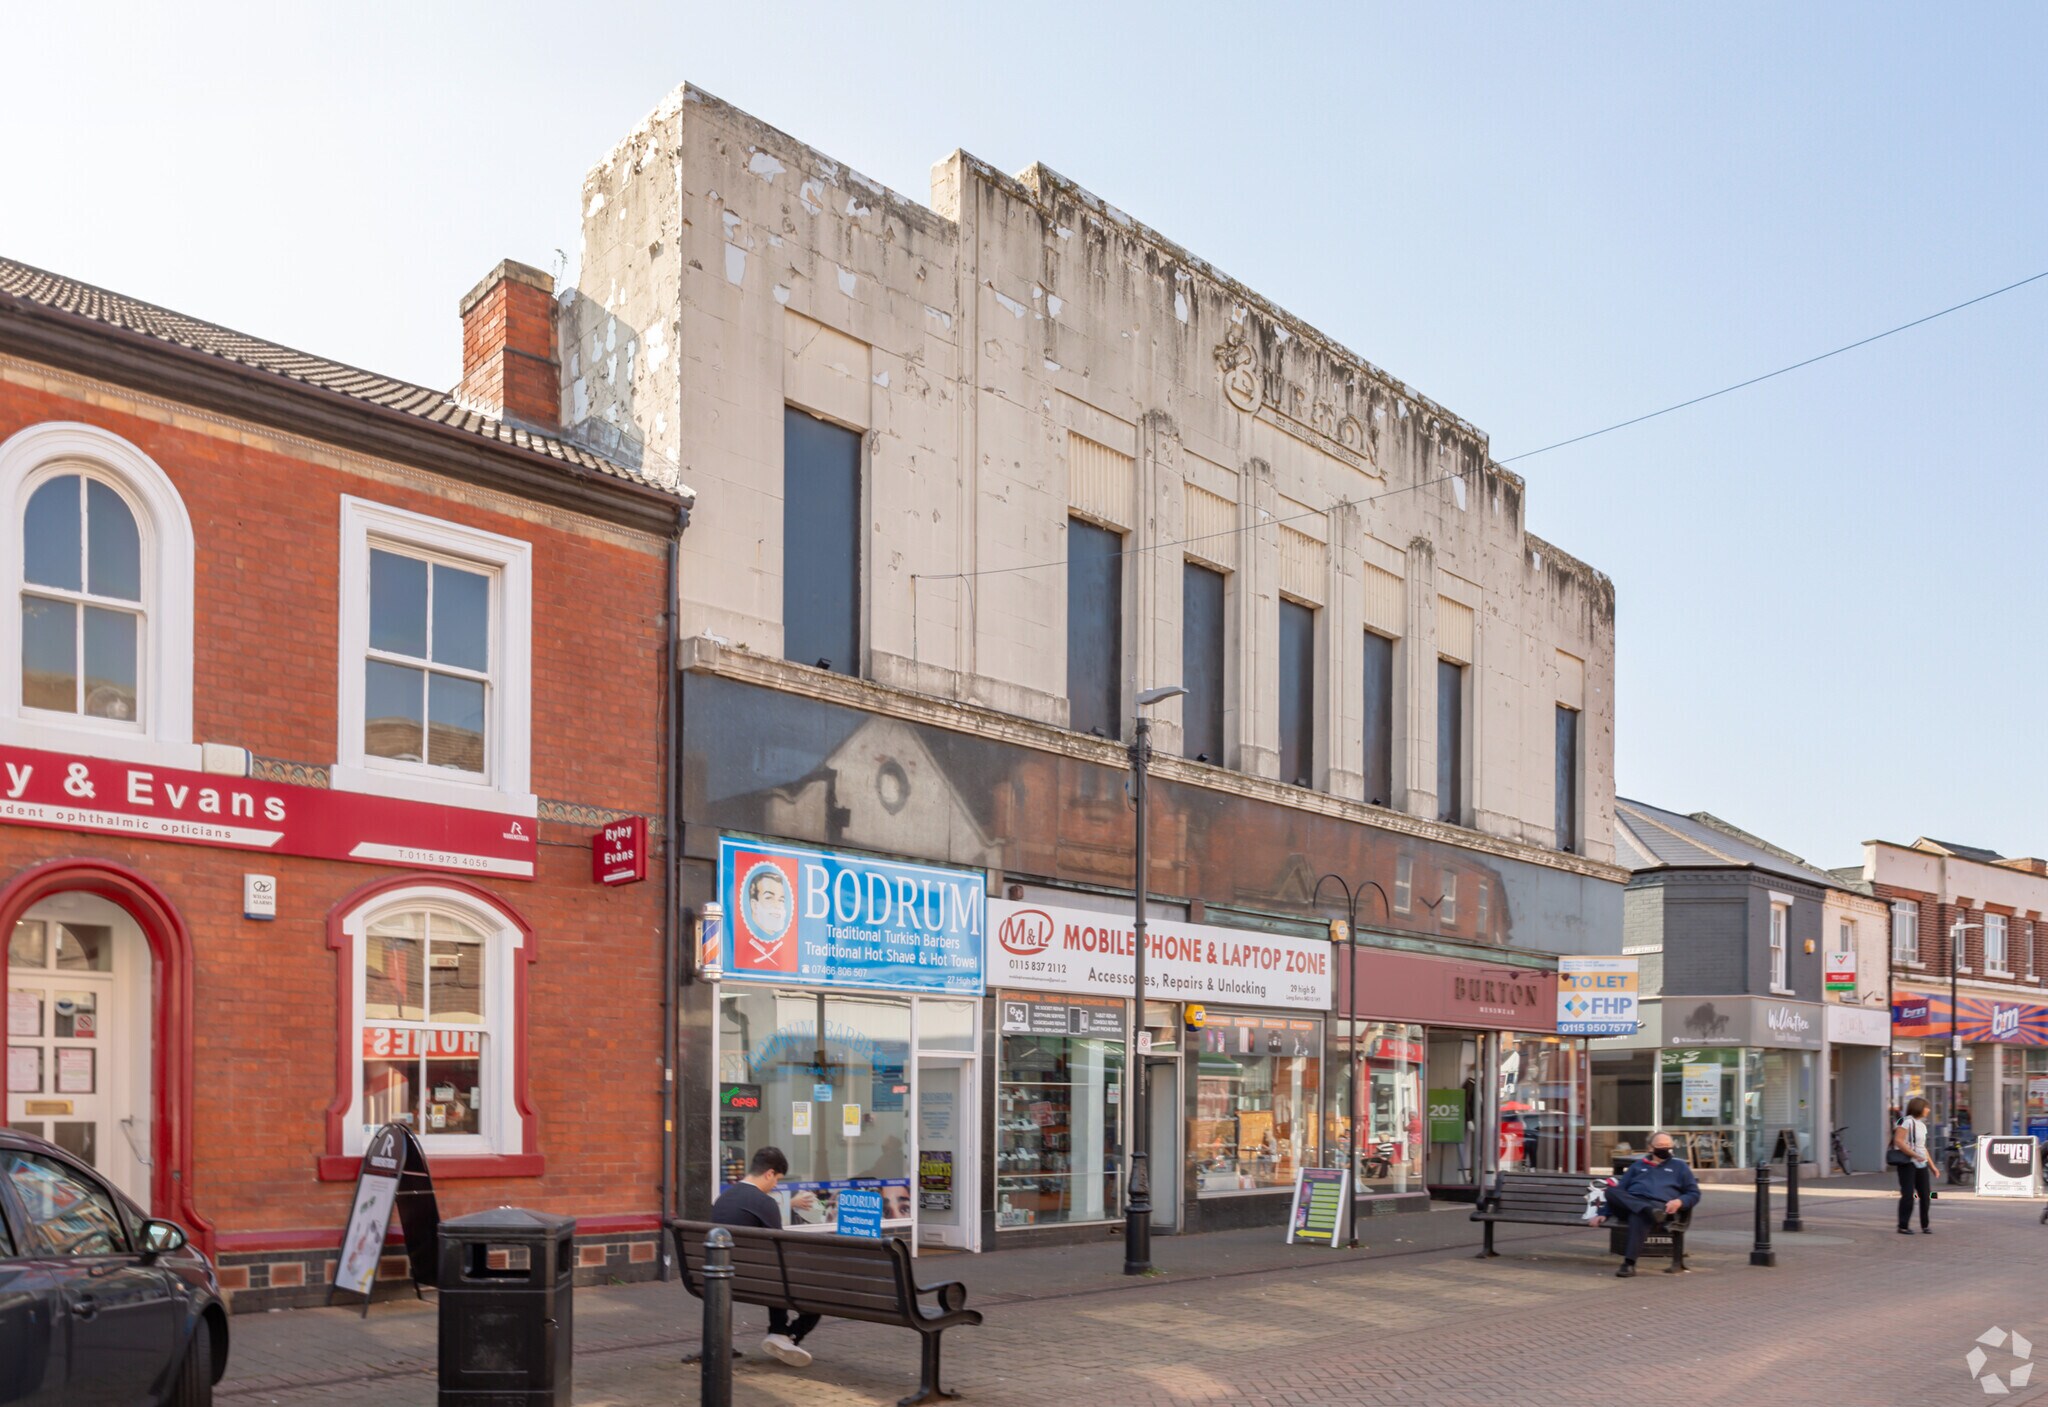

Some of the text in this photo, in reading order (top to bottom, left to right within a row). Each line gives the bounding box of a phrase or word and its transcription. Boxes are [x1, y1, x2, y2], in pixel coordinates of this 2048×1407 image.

[63, 762, 98, 800] &
[127, 769, 287, 822] Evans
[56, 811, 150, 830] ophthalmic
[161, 822, 232, 840] opticians
[605, 825, 633, 843] Ryley
[438, 853, 458, 865] 973
[462, 856, 489, 869] 4056
[603, 848, 634, 866] Evans
[804, 864, 980, 935] BODRUM
[826, 924, 961, 949] Traditional Turkish Barbers
[1004, 917, 1049, 947] M&L
[805, 941, 978, 969] Traditional Hot Shave & Hot Towel
[1063, 923, 1135, 956] MOBILE
[1206, 941, 1218, 965] &
[1222, 942, 1282, 971] LAPTOP
[1285, 950, 1326, 975] ZONE
[811, 965, 836, 977] 07466
[1009, 959, 1067, 973] 0115 837 2112
[1088, 966, 1159, 989] Accessoes,
[1162, 973, 1204, 991] Repairs
[1206, 977, 1215, 991] &
[1218, 978, 1267, 998] Unlocking
[1290, 984, 1317, 996] 29 high St
[1569, 975, 1628, 988] TO LET
[1454, 976, 1538, 1007] BURTON
[1478, 1006, 1516, 1016] MENSWEAR
[1591, 997, 1633, 1015] FHP
[1561, 1023, 1633, 1033] 0115 950 7577
[731, 1097, 758, 1108] OPEN
[839, 1193, 881, 1210] BODRUM
[843, 1214, 875, 1226] Traditional
[840, 1226, 852, 1235] Hot
[853, 1227, 870, 1237] Shave
